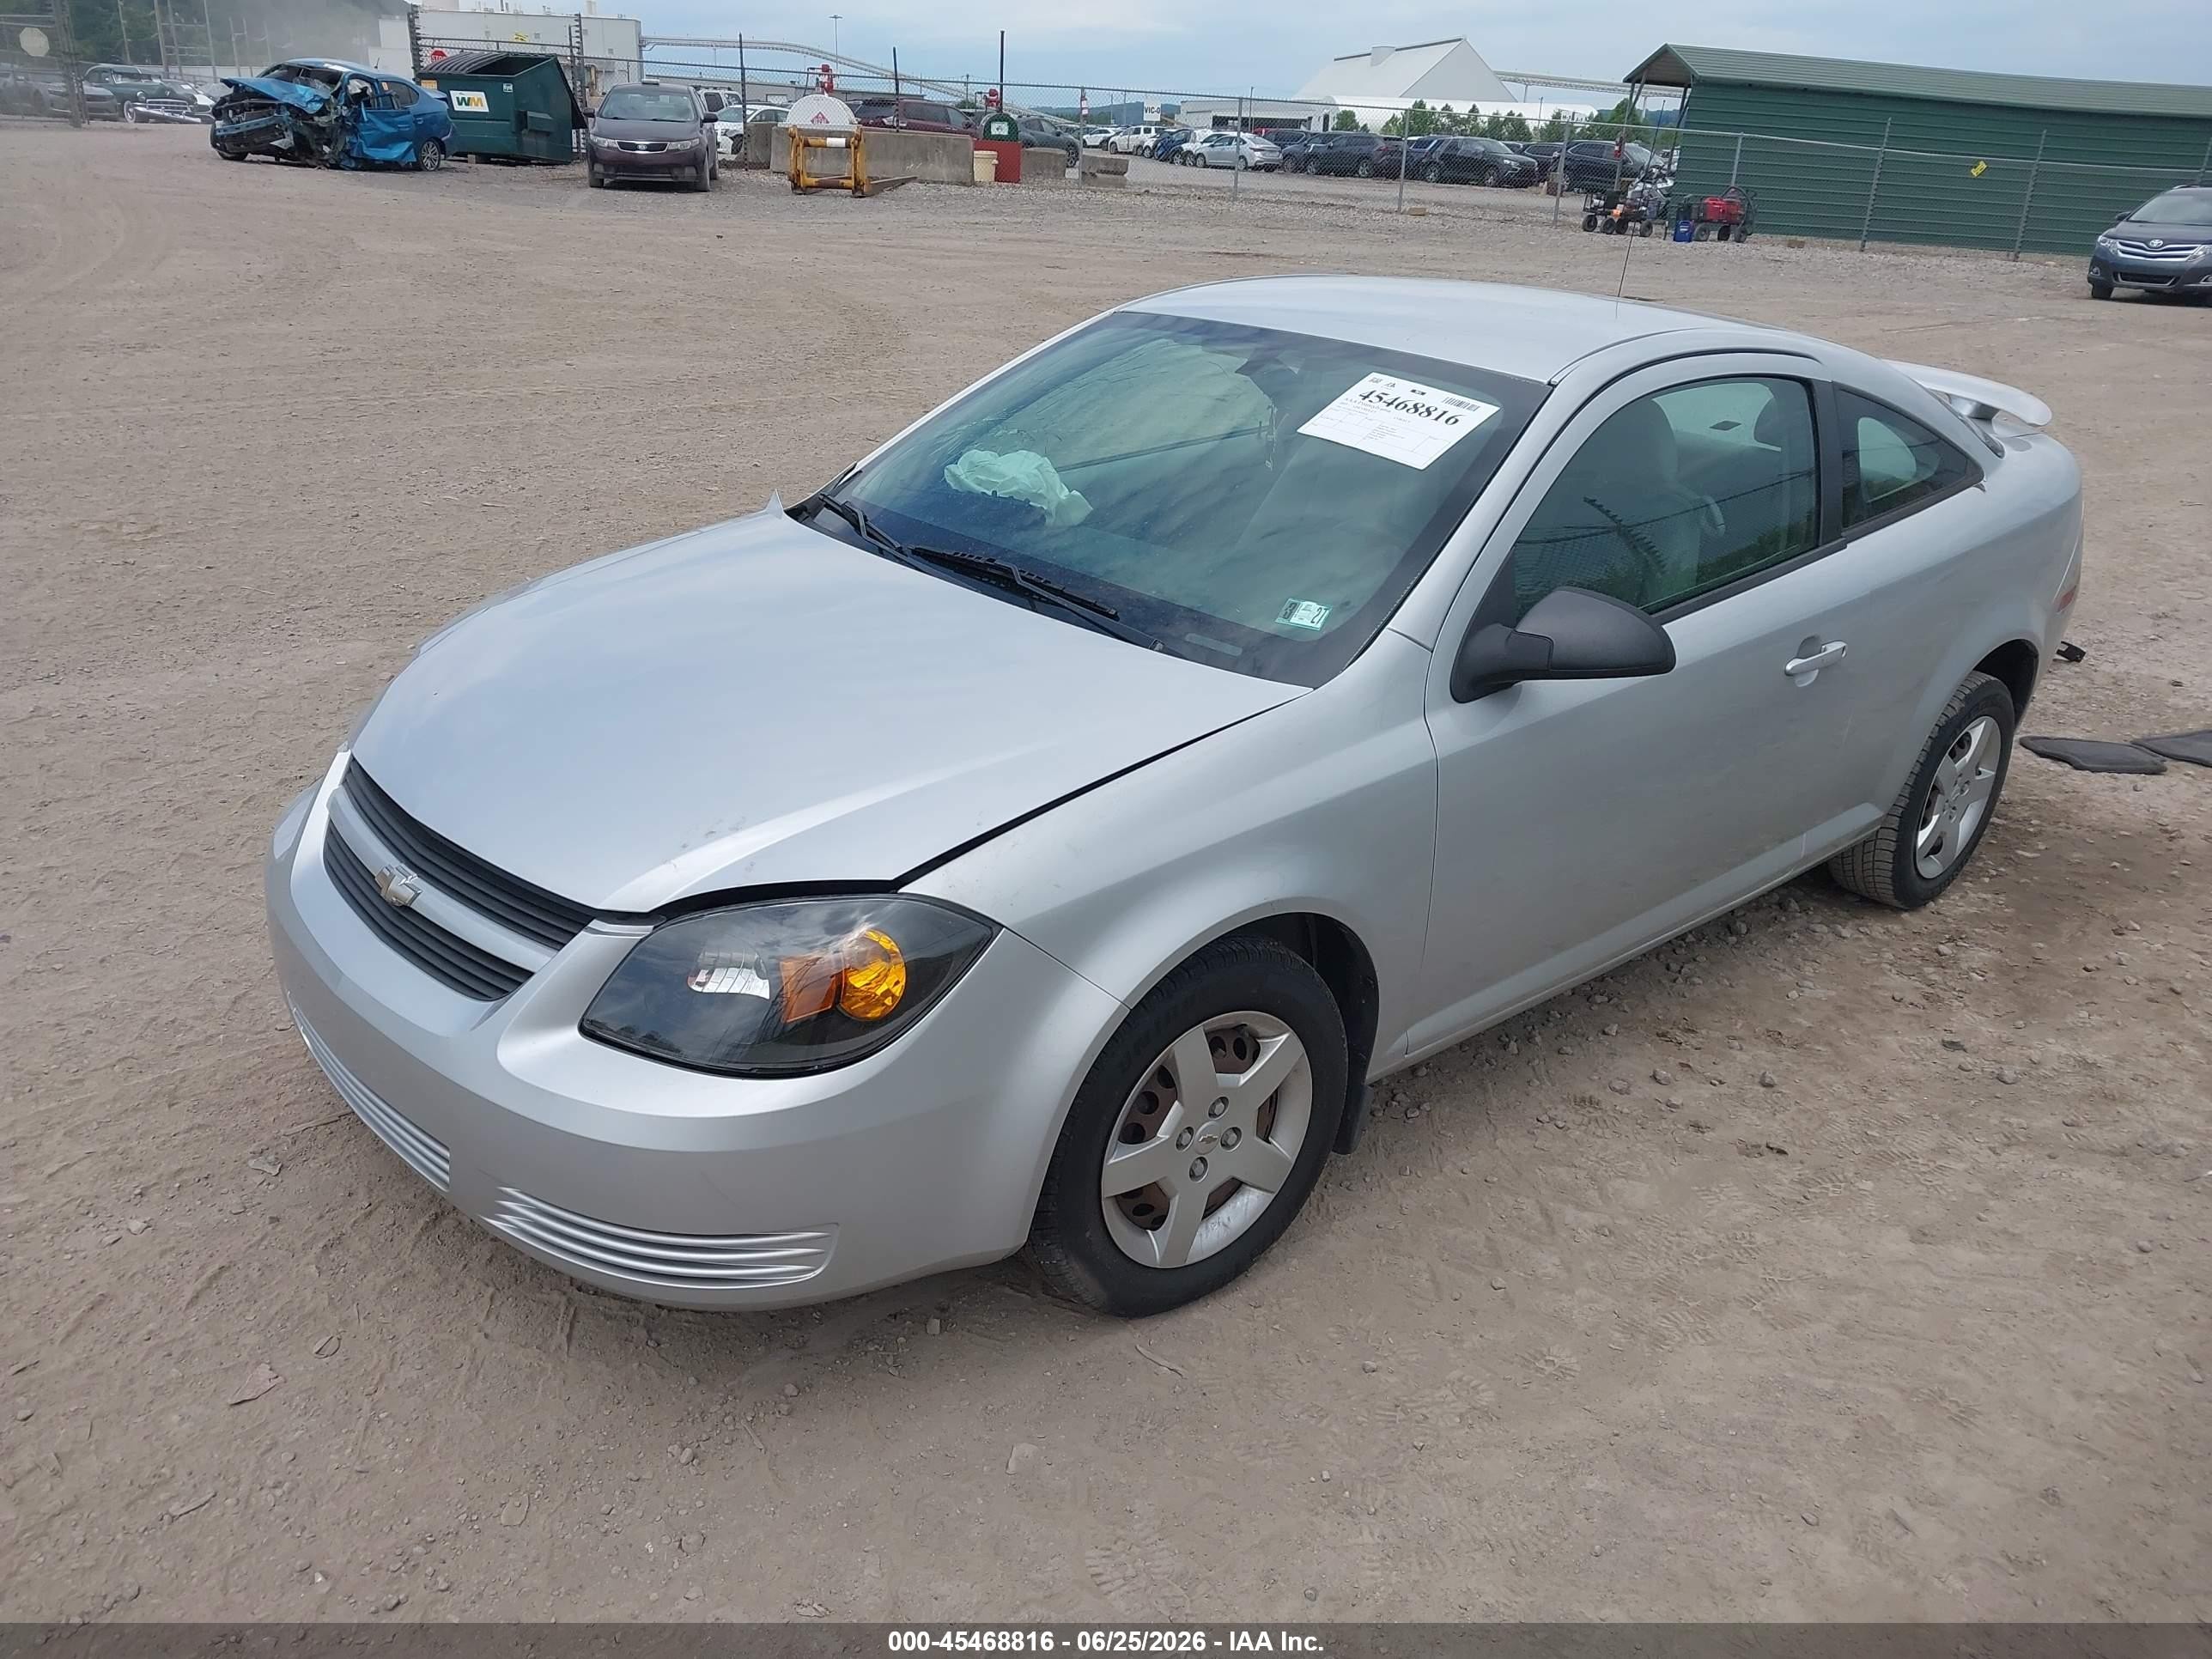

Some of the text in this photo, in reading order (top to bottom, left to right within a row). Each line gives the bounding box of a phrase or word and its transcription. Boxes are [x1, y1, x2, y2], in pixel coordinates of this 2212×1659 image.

[456, 96, 483, 106] WM
[1358, 390, 1465, 426] 45468816
[1282, 602, 1297, 620] 3
[1310, 607, 1329, 625] 27
